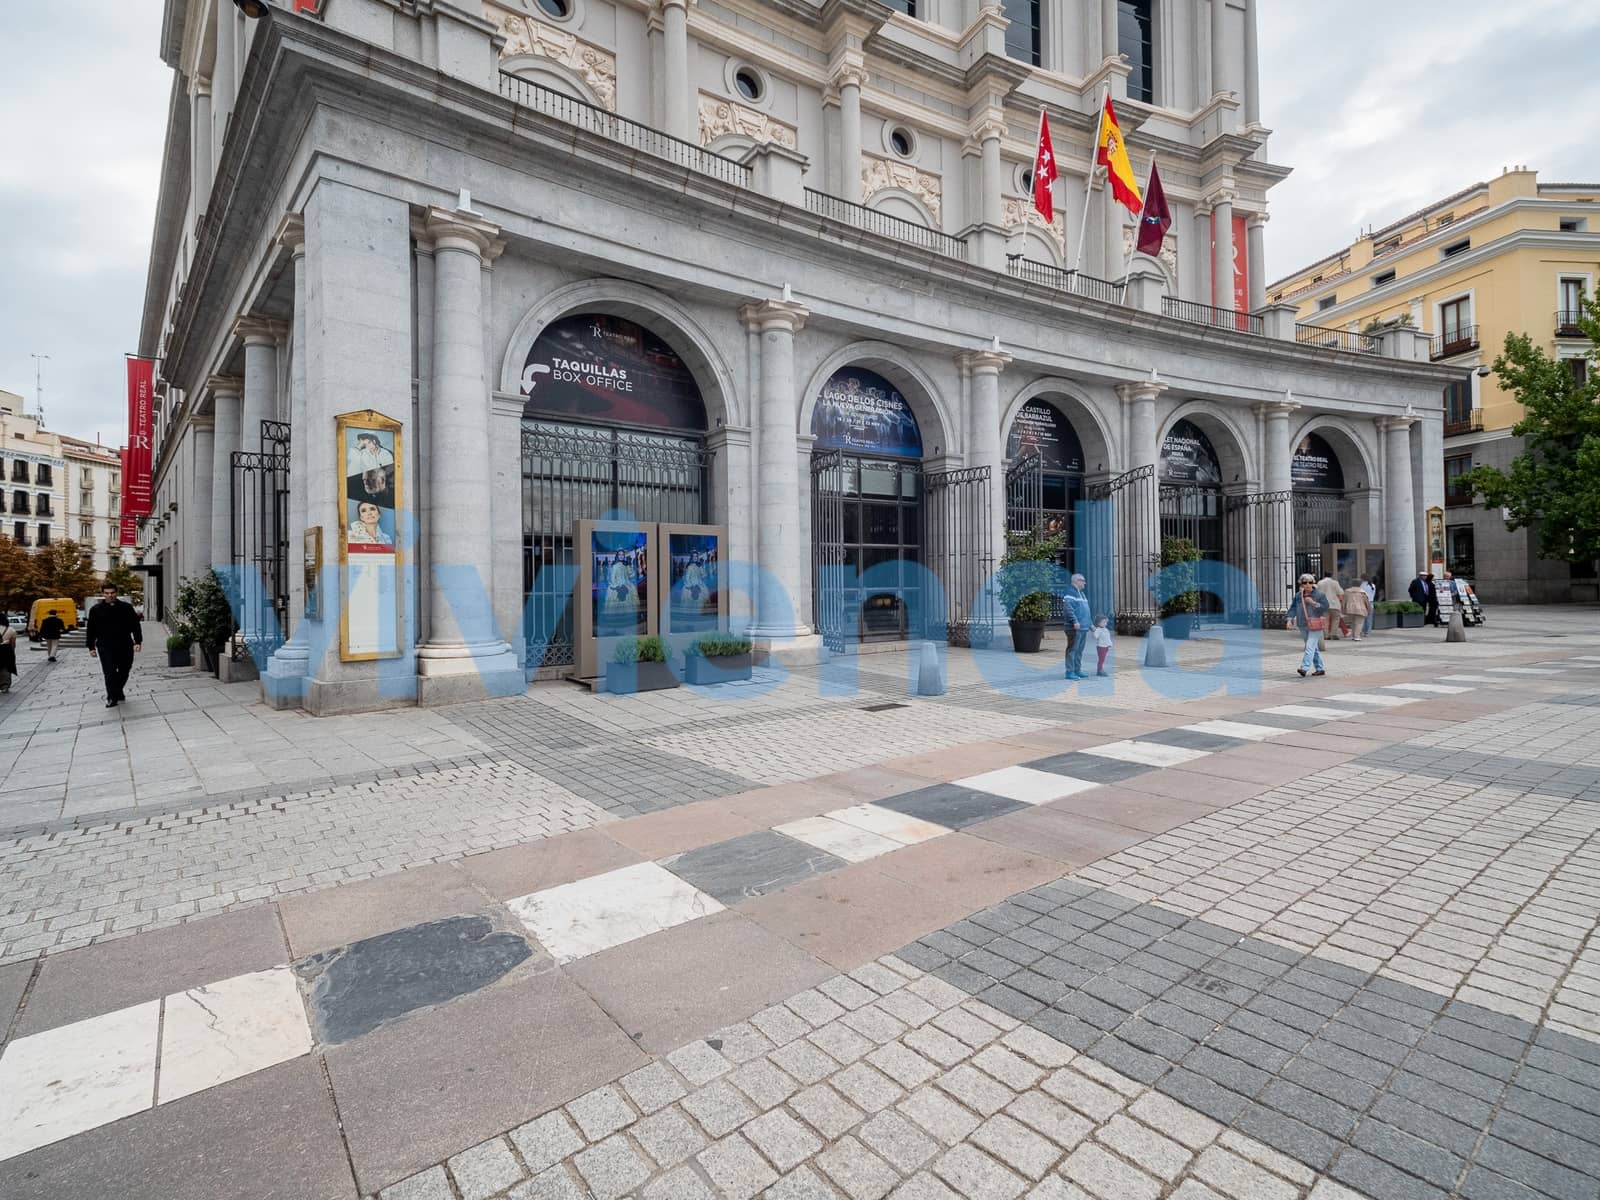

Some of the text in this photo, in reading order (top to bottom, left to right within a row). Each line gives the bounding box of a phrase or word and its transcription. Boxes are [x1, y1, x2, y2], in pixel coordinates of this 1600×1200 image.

[552, 357, 627, 380] TAQUILLAS
[553, 369, 633, 392] BOX OFFICE
[139, 379, 147, 426] TEATRO REAL
[823, 390, 904, 411] LAGO DE LOS CISNES
[1025, 406, 1052, 415] CASTILLO
[1024, 412, 1054, 422] BARBAZUL
[1173, 437, 1201, 446] NACIONAL
